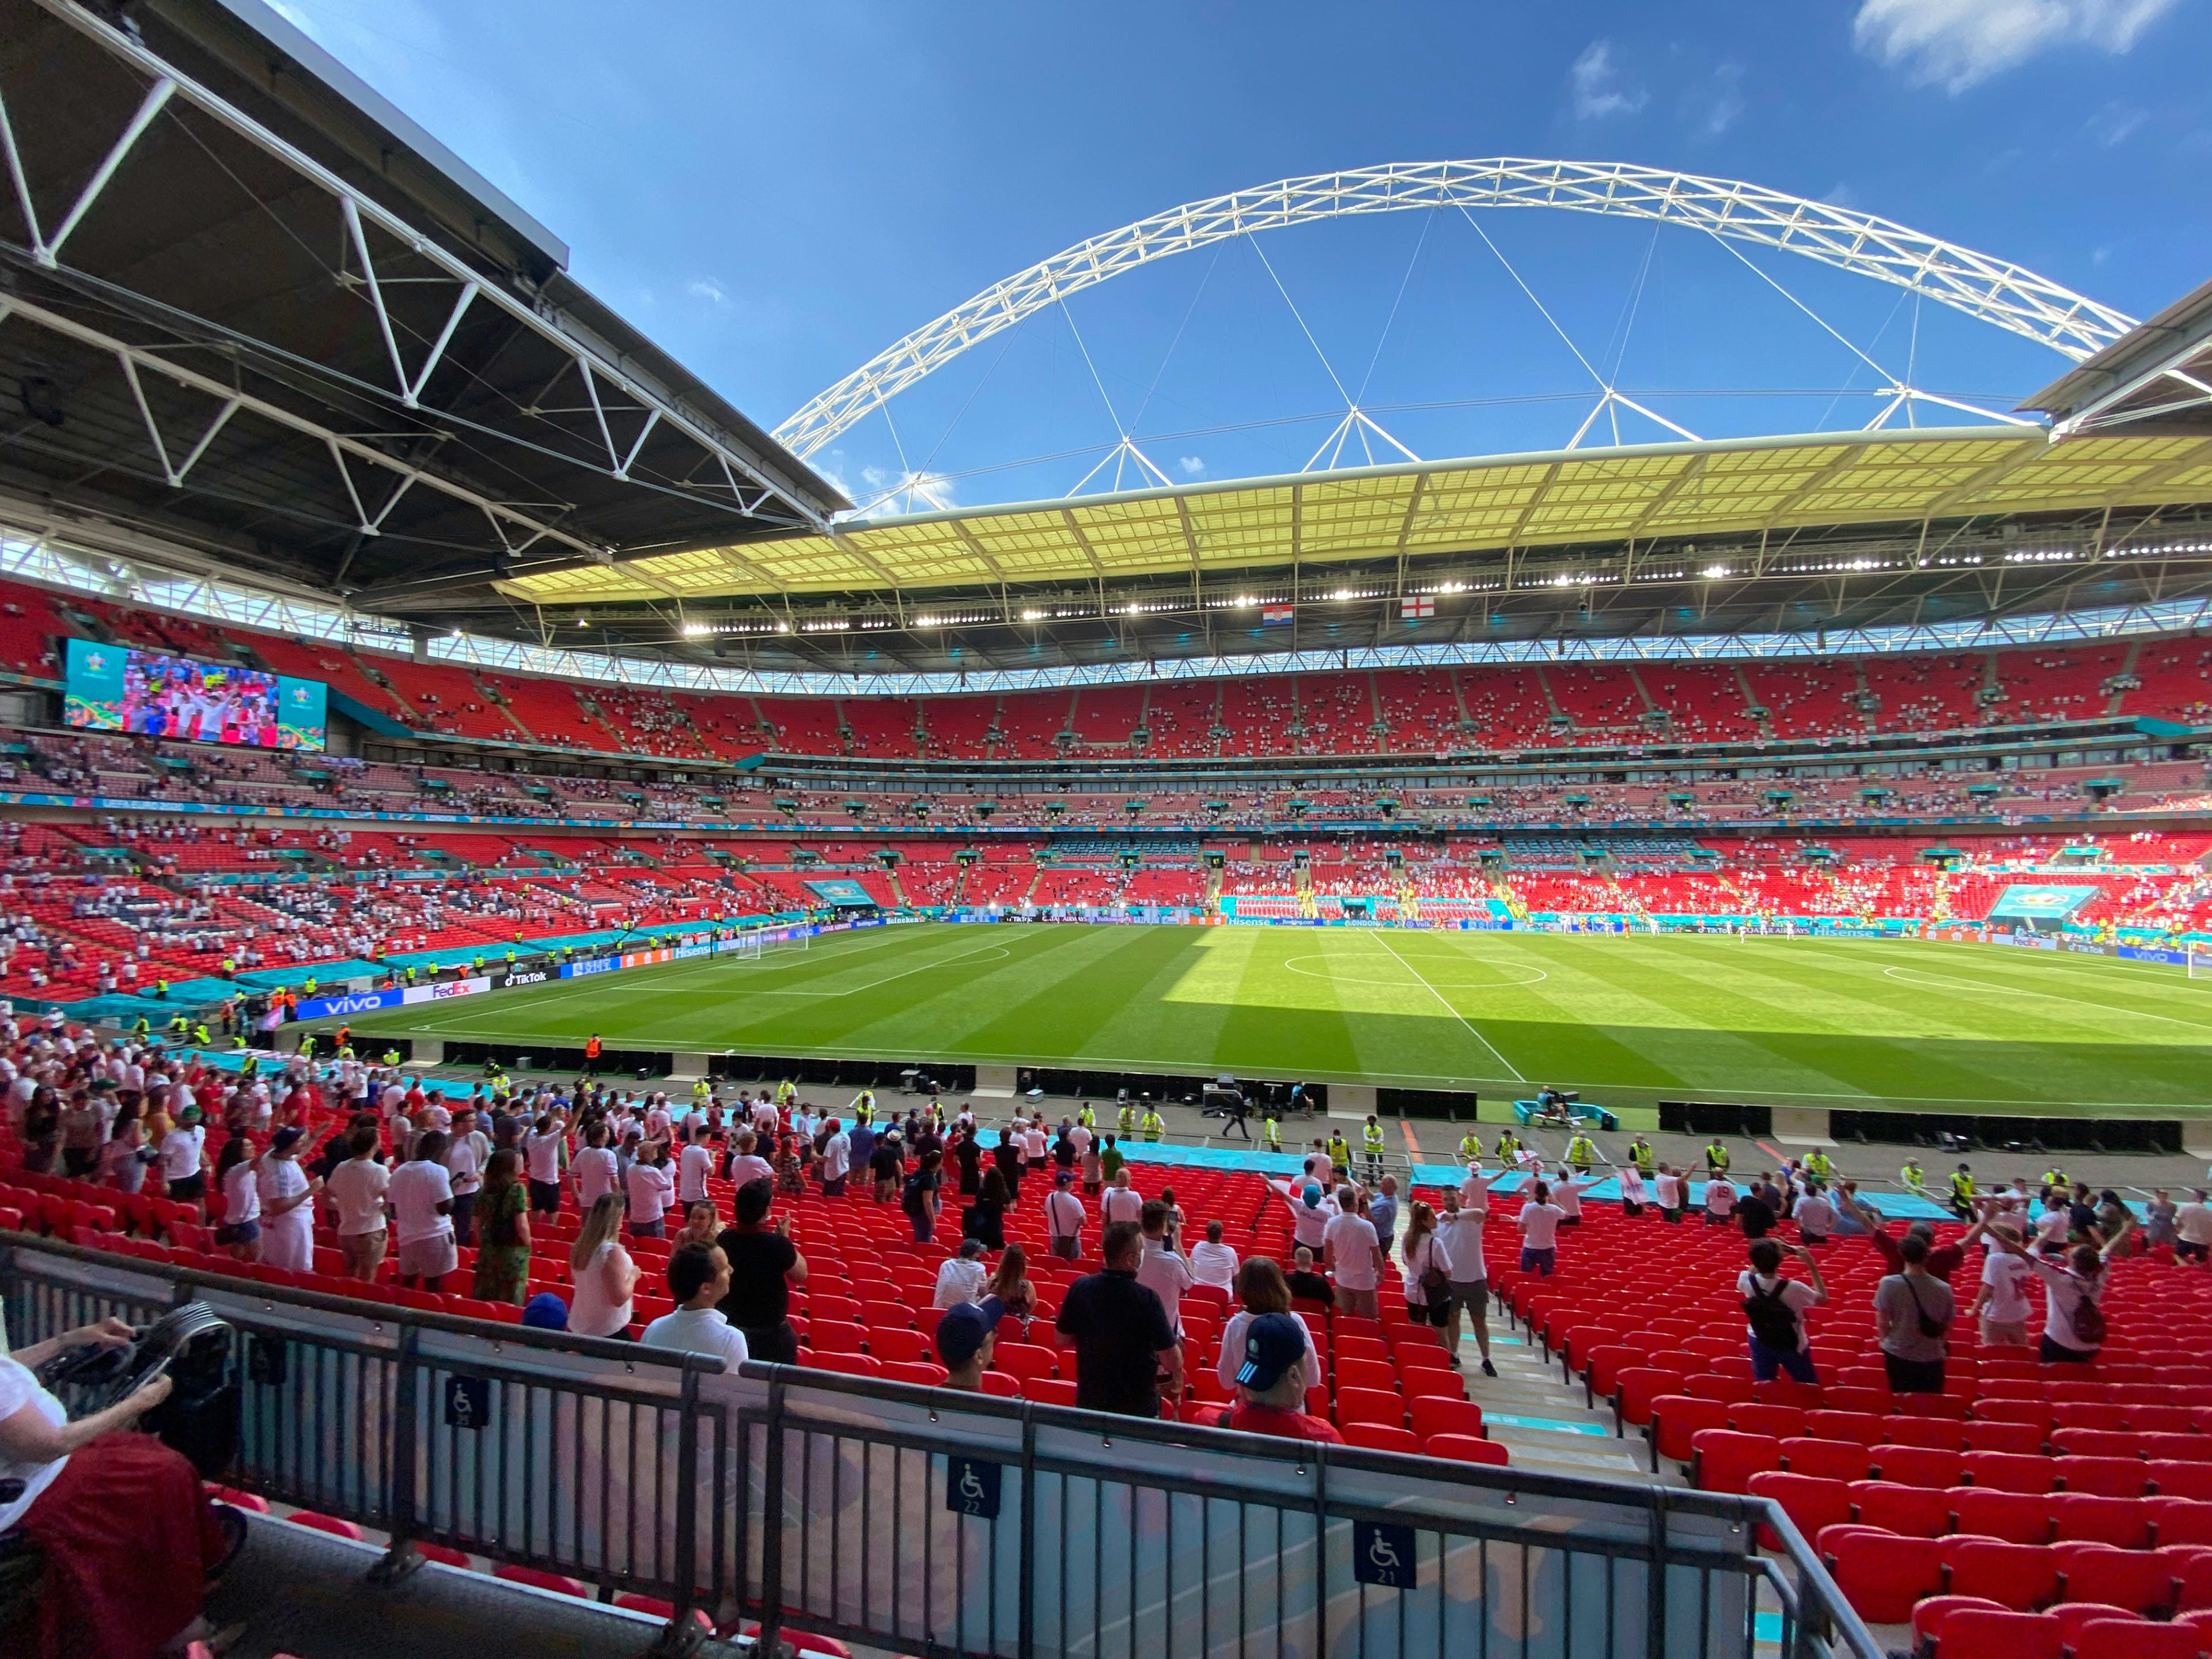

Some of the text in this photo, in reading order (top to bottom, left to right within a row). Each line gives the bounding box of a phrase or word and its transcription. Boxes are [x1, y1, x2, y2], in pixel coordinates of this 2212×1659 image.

[1815, 925, 1874, 937] Hisense
[2013, 936, 2040, 948] FedEx
[2078, 945, 2104, 955] TikTok
[2134, 950, 2168, 962] vivo
[516, 971, 547, 985] TikTok
[433, 982, 470, 998] FedEx
[325, 995, 381, 1014] vivo
[964, 1499, 980, 1514] 22
[1378, 1569, 1395, 1585] 21
